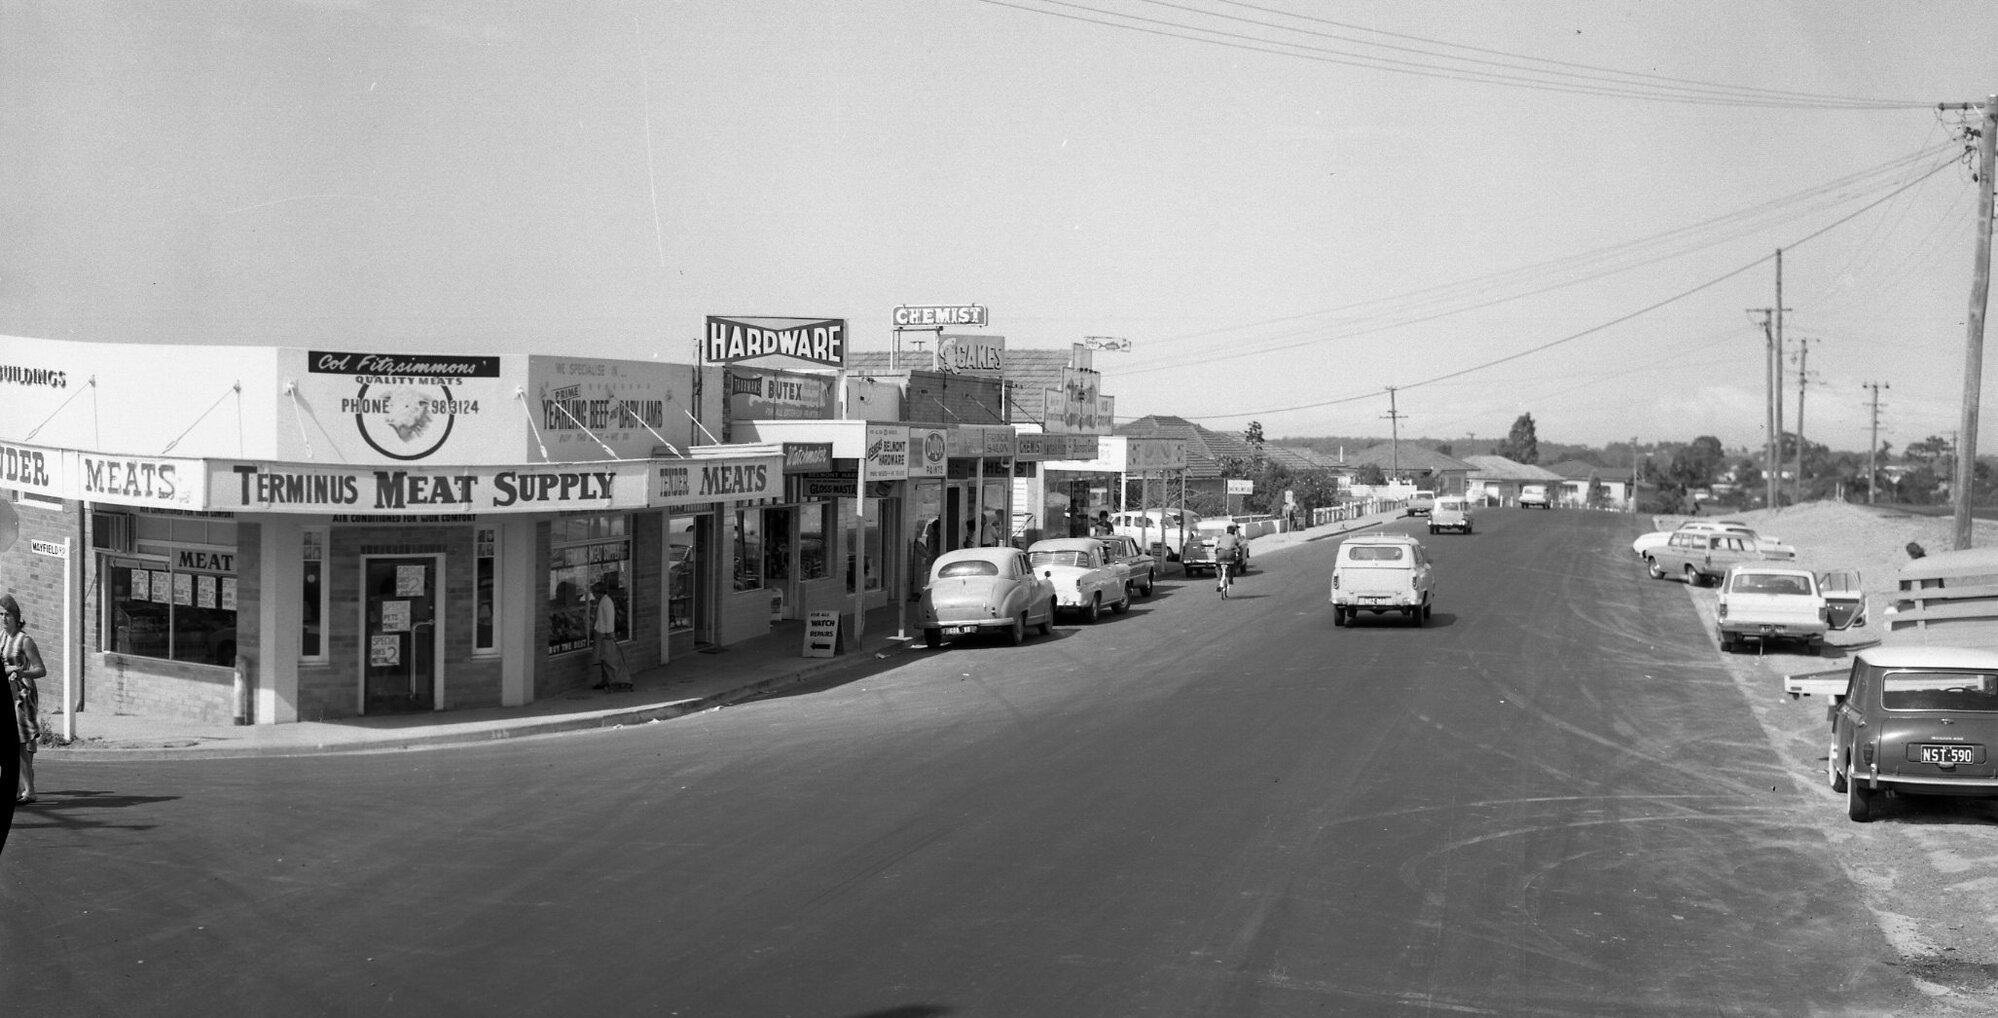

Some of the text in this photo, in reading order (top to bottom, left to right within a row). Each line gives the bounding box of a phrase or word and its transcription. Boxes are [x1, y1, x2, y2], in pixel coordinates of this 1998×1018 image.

[896, 307, 982, 324] CHEMIST
[710, 322, 842, 363] HARDWARE
[318, 354, 351, 370] Col
[956, 344, 1002, 370] CAKES
[355, 376, 463, 386] QUALITY MEATS
[555, 386, 579, 401] PRIME
[768, 380, 802, 401] BUTEX
[341, 398, 391, 414] PHONE
[542, 400, 587, 430] YEARLING
[590, 400, 609, 429] BEEF
[619, 400, 638, 429] BABY
[641, 400, 663, 428] LAMB
[884, 441, 906, 452] BELMONT
[878, 454, 905, 466] HARDWARE
[926, 465, 943, 474] PAINTS
[85, 458, 176, 499] MEATS
[660, 464, 767, 497] TENDER MEATS
[234, 465, 616, 509] TERMINUS MEAT SUPPLY
[333, 514, 348, 523] AIR
[351, 514, 400, 523] CONDITIONED
[403, 514, 417, 523] FOR
[442, 514, 476, 522] COMFORT
[32, 541, 59, 555] MAYFIELD
[179, 551, 234, 571] MEAT
[811, 619, 835, 627] WATCH
[373, 636, 398, 646] SPECIAL
